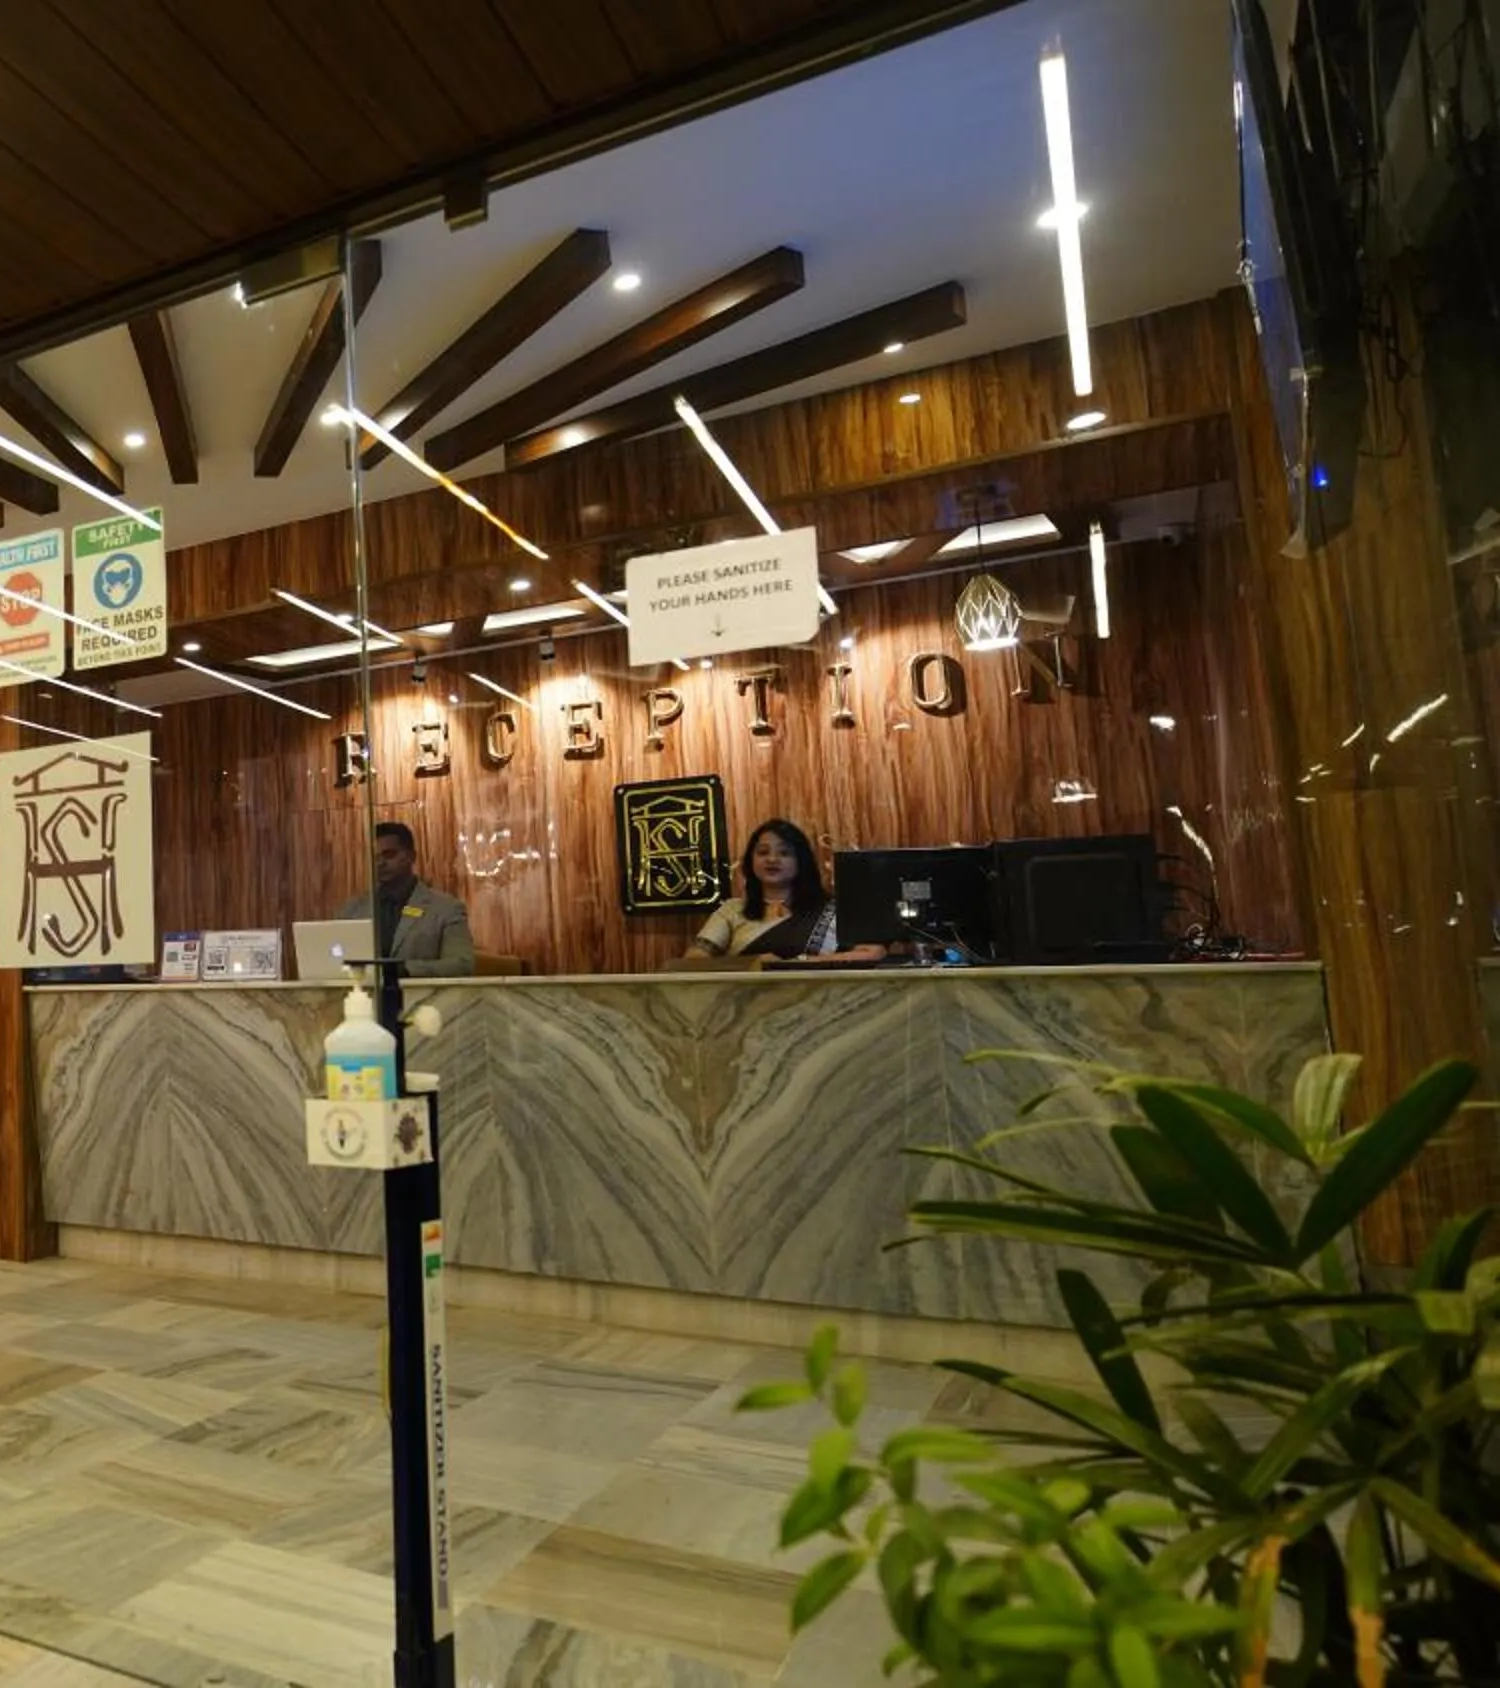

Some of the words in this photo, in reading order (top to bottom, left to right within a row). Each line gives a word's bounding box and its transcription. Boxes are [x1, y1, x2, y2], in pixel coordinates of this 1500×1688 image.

[89, 519, 145, 542] SAFETY
[103, 535, 131, 548] FIRST
[657, 571, 707, 590] PLEASE
[713, 558, 781, 580] SANITIZE
[649, 592, 691, 612] YOUR
[695, 587, 749, 607] HANDS
[753, 579, 793, 596] HERE
[114, 606, 164, 627] MASKS
[336, 629, 1074, 788] RECEPTION
[432, 1343, 446, 1478] SANITIZER
[436, 1488, 449, 1578] STAND
